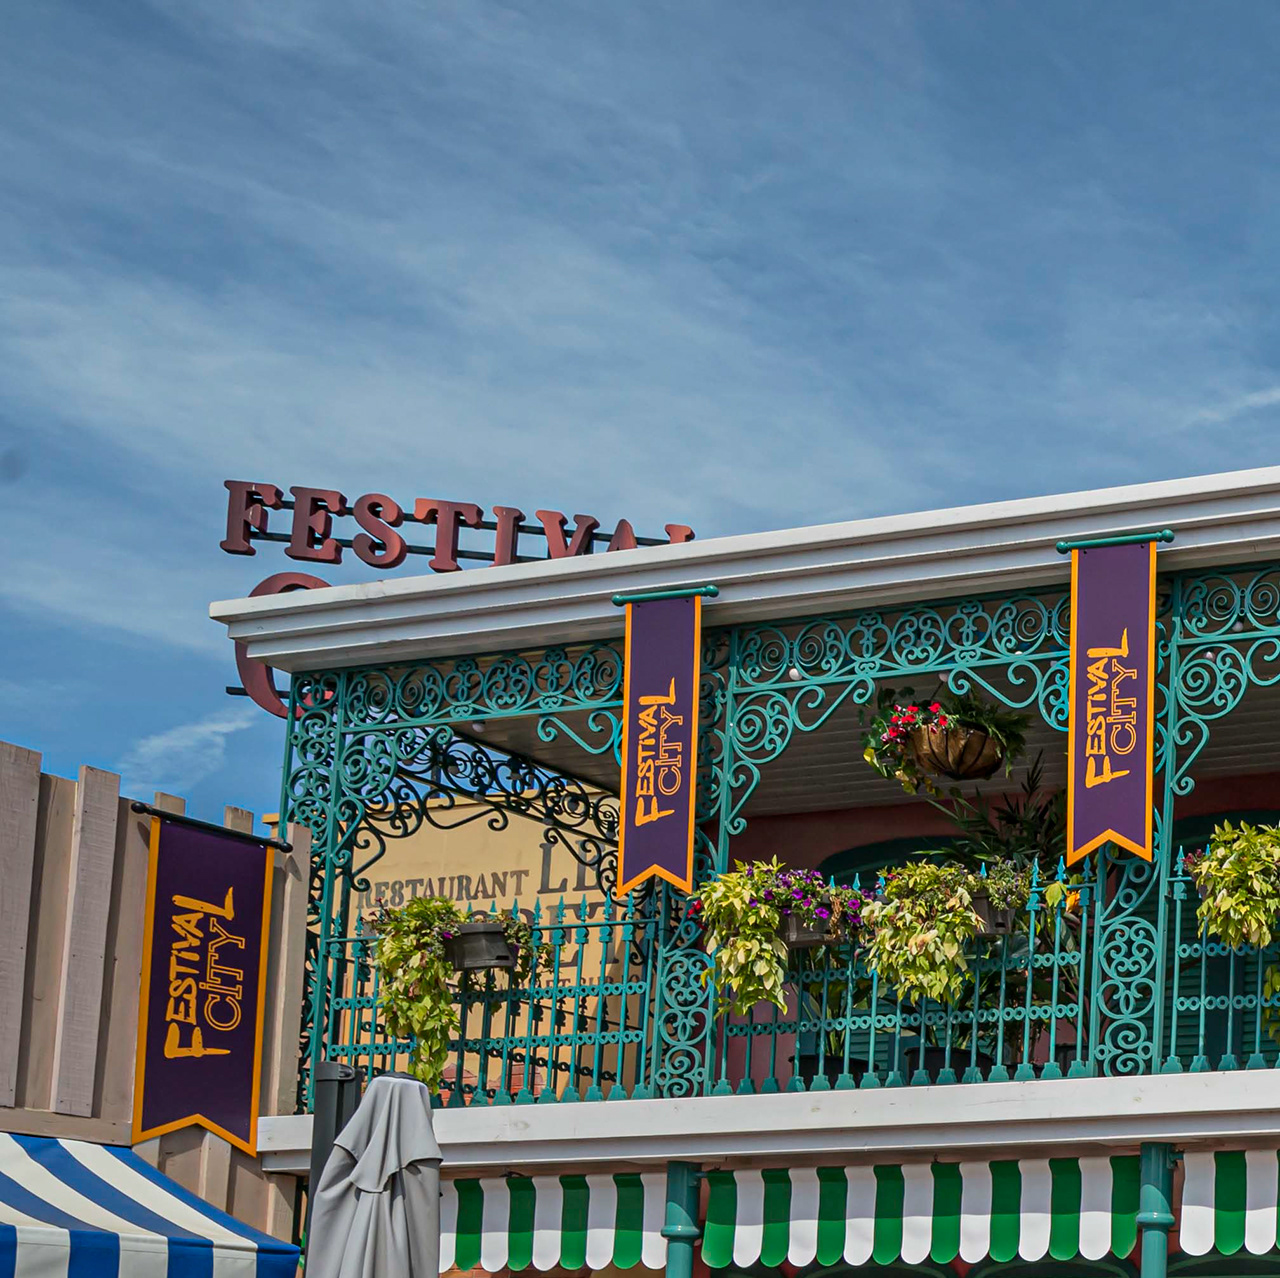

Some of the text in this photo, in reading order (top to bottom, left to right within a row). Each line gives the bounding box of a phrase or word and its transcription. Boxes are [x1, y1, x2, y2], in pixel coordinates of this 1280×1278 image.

[219, 479, 695, 573] FESTIV
[634, 677, 677, 827] FESTIVAL
[654, 705, 684, 796] CITY
[1085, 628, 1131, 789] FESTIVAL
[1106, 658, 1138, 755] CITY
[163, 886, 235, 1059] FESTIVAL
[199, 917, 246, 1031] CITY
